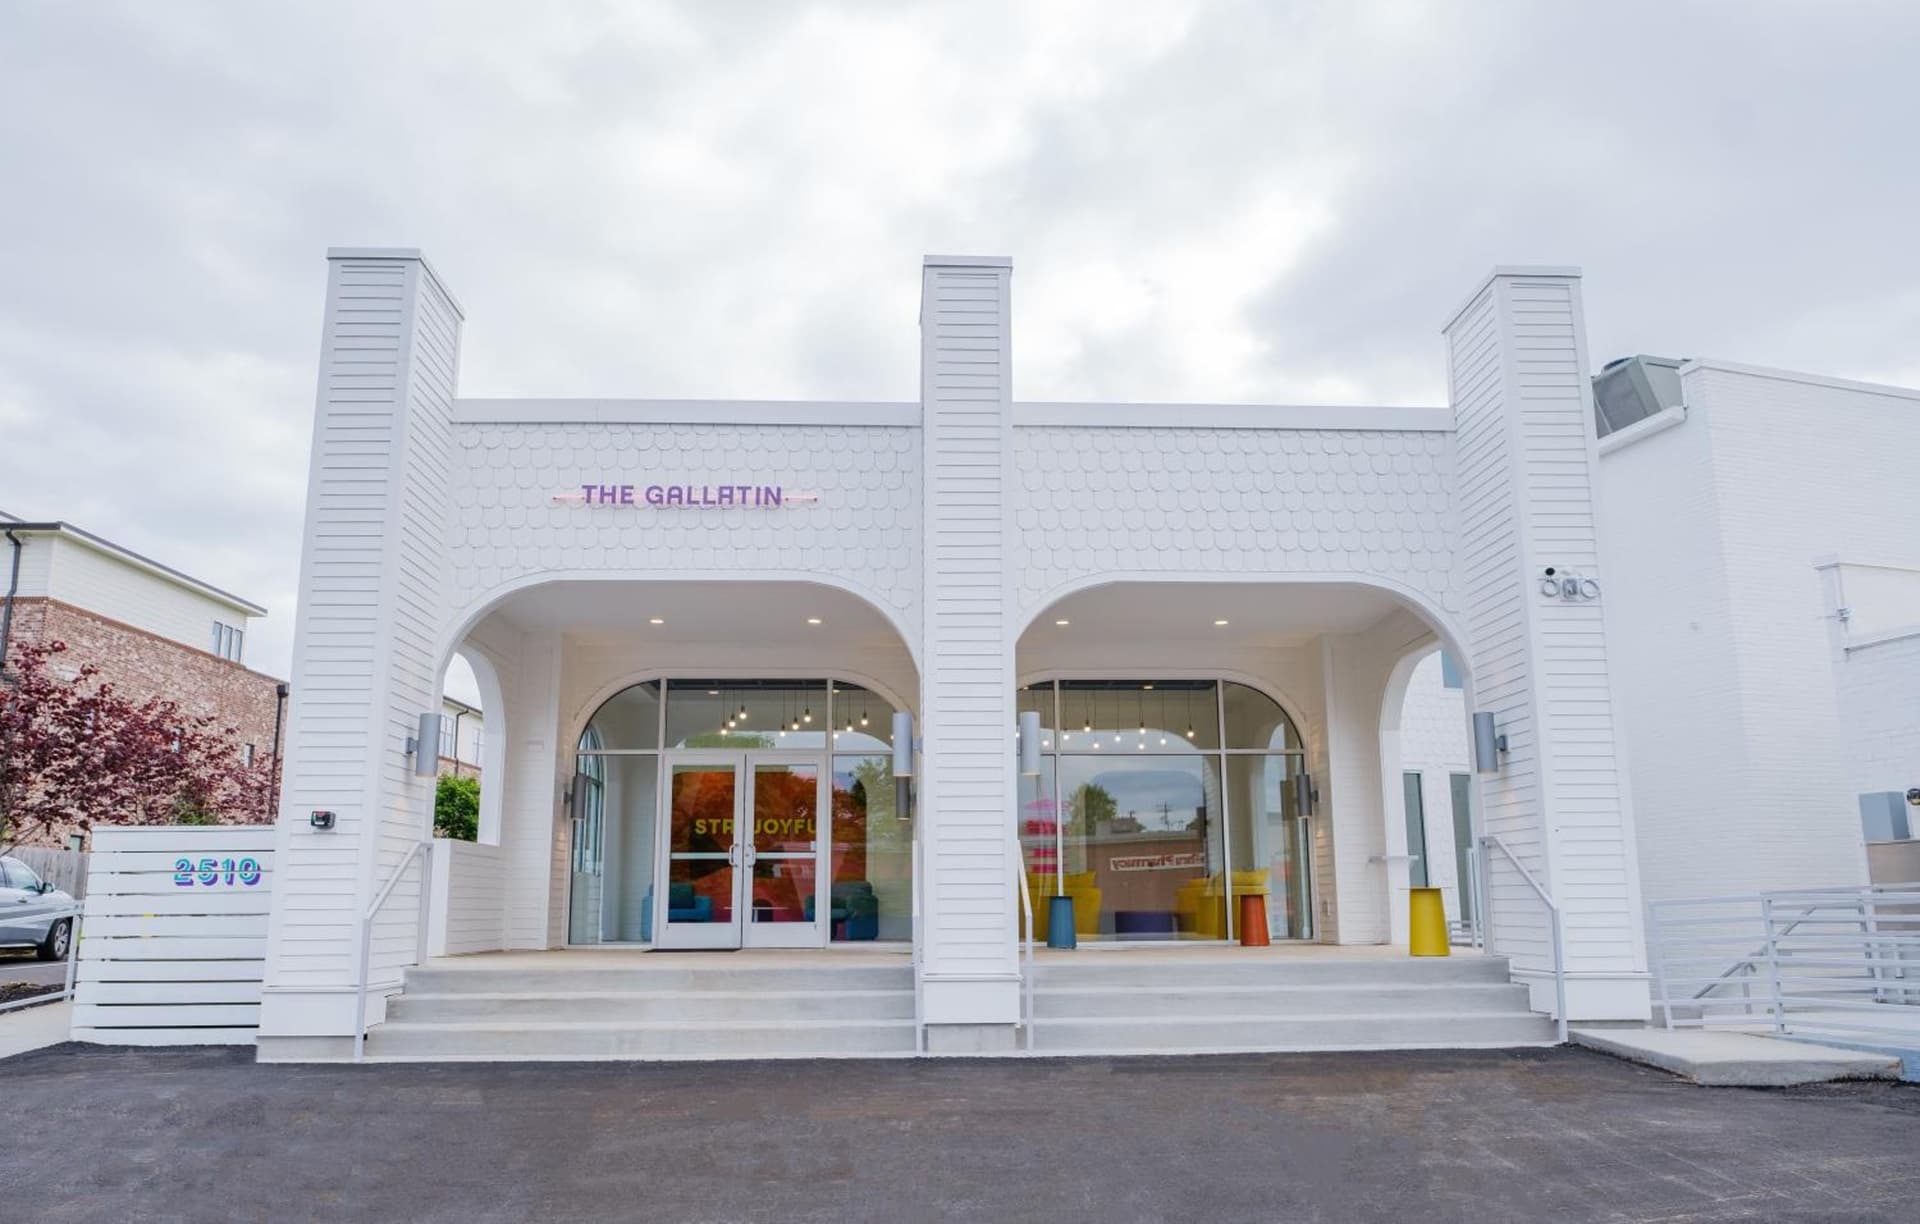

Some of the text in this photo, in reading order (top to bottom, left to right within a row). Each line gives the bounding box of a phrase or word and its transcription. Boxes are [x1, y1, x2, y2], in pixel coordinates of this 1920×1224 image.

[582, 485, 782, 506] THE GALLATIN
[754, 818, 817, 835] JOYFU
[174, 857, 262, 887] 2510
